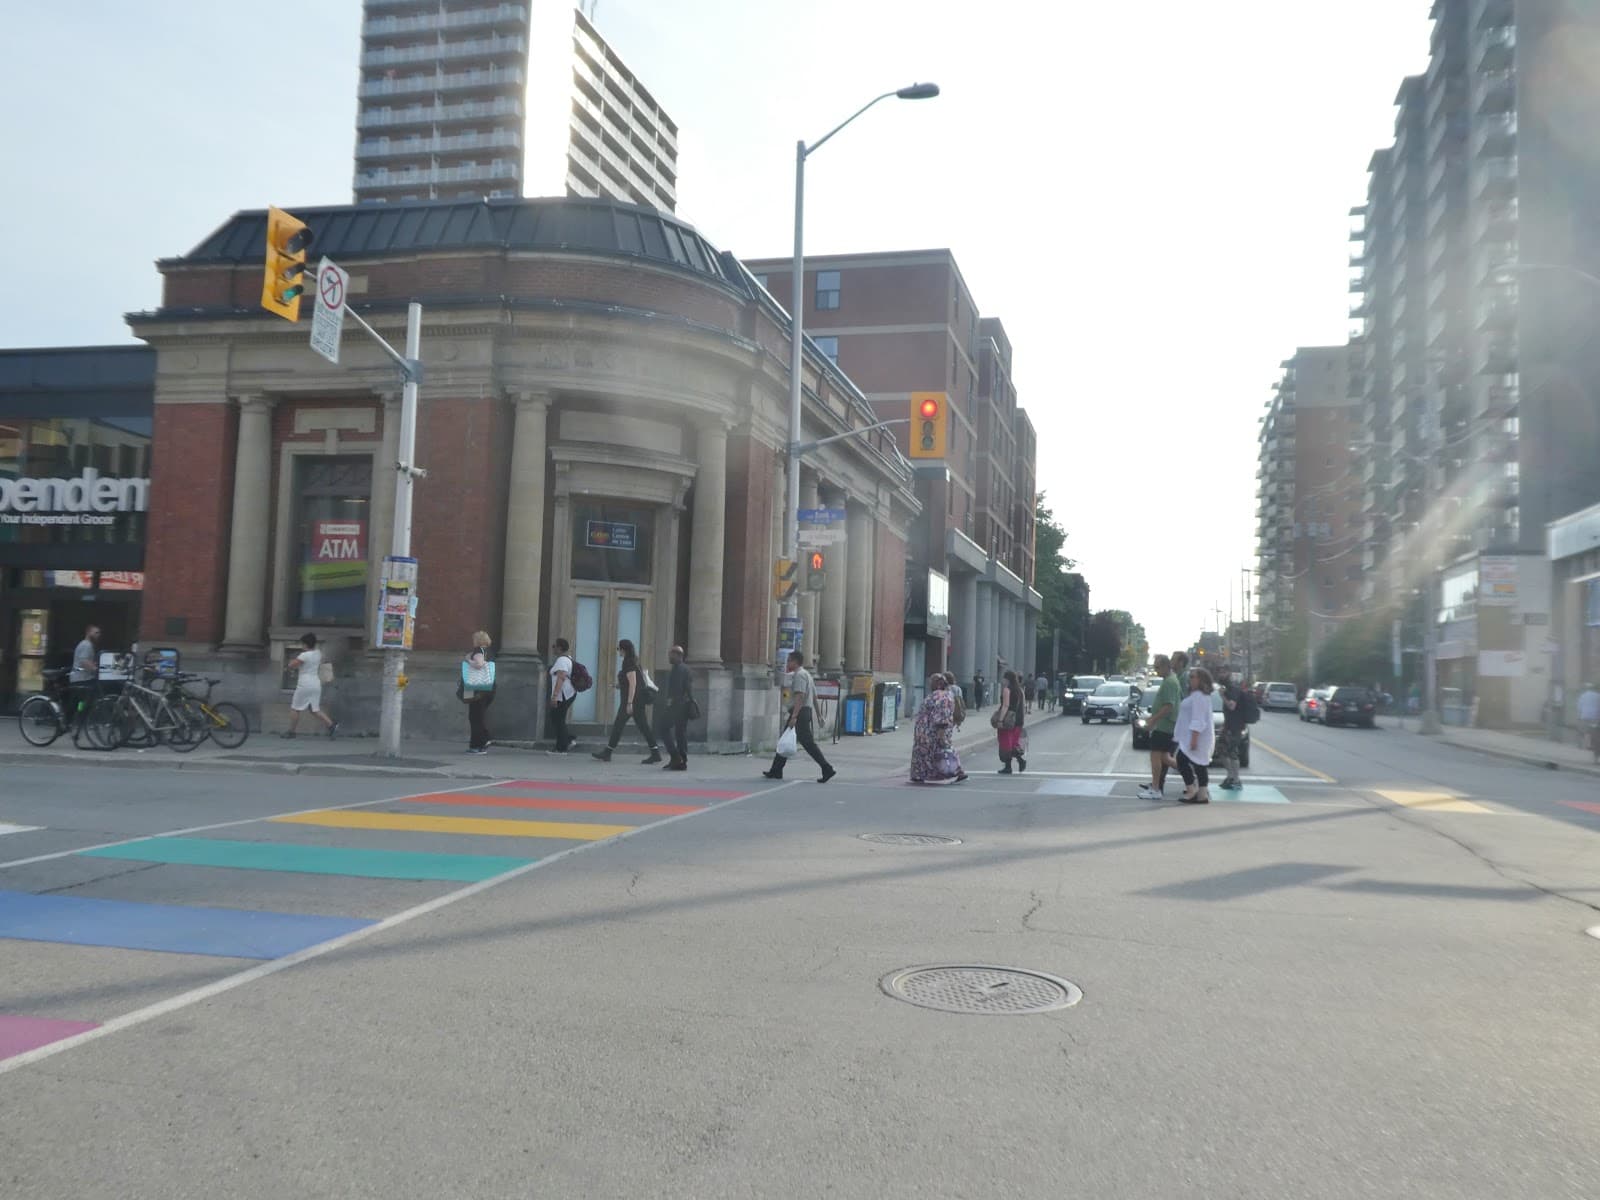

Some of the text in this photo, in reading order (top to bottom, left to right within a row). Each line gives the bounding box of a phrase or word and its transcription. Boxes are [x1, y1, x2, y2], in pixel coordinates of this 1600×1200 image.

[21, 513, 80, 526] Independent
[81, 513, 115, 525] Grocer
[319, 539, 359, 559] ATM
